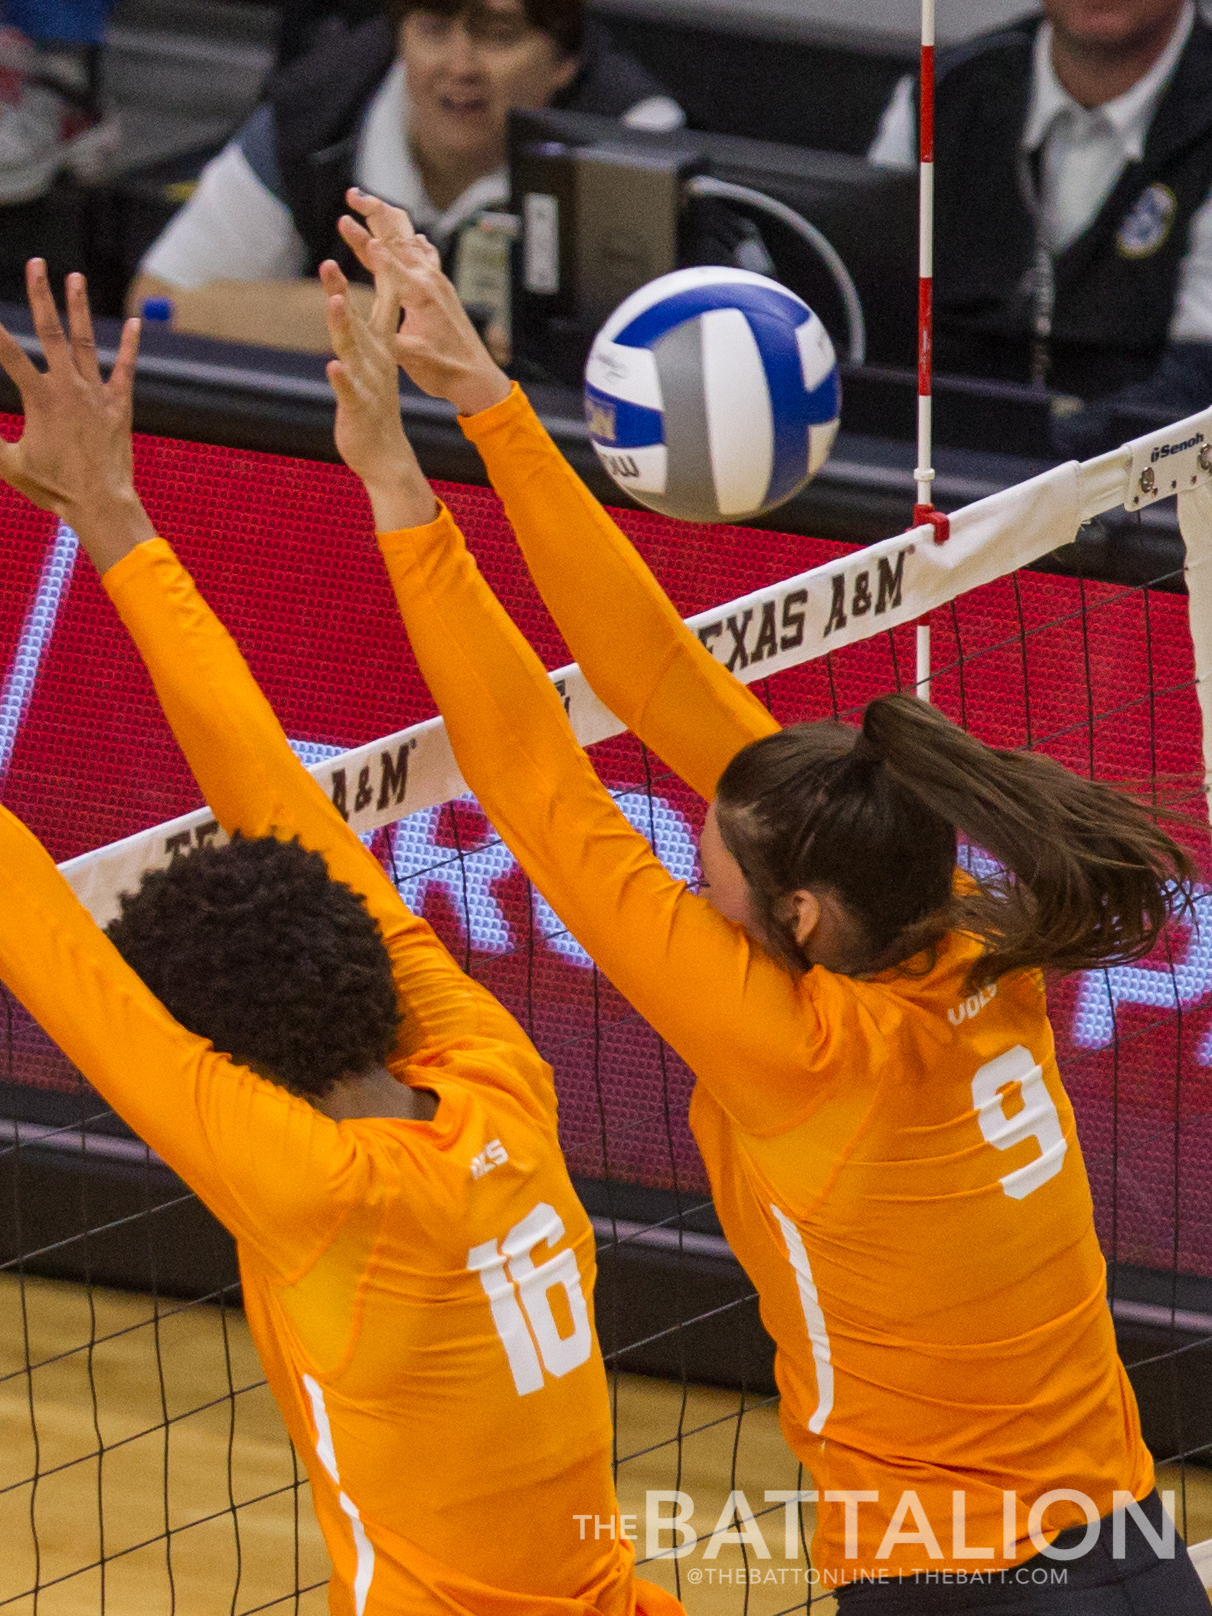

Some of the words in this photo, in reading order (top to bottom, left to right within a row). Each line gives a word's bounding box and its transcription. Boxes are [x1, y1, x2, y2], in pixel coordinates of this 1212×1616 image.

[1160, 432, 1204, 458] Senoh
[697, 588, 809, 672] EXAS
[971, 1044, 1068, 1200] 9
[467, 1201, 592, 1396] 16
